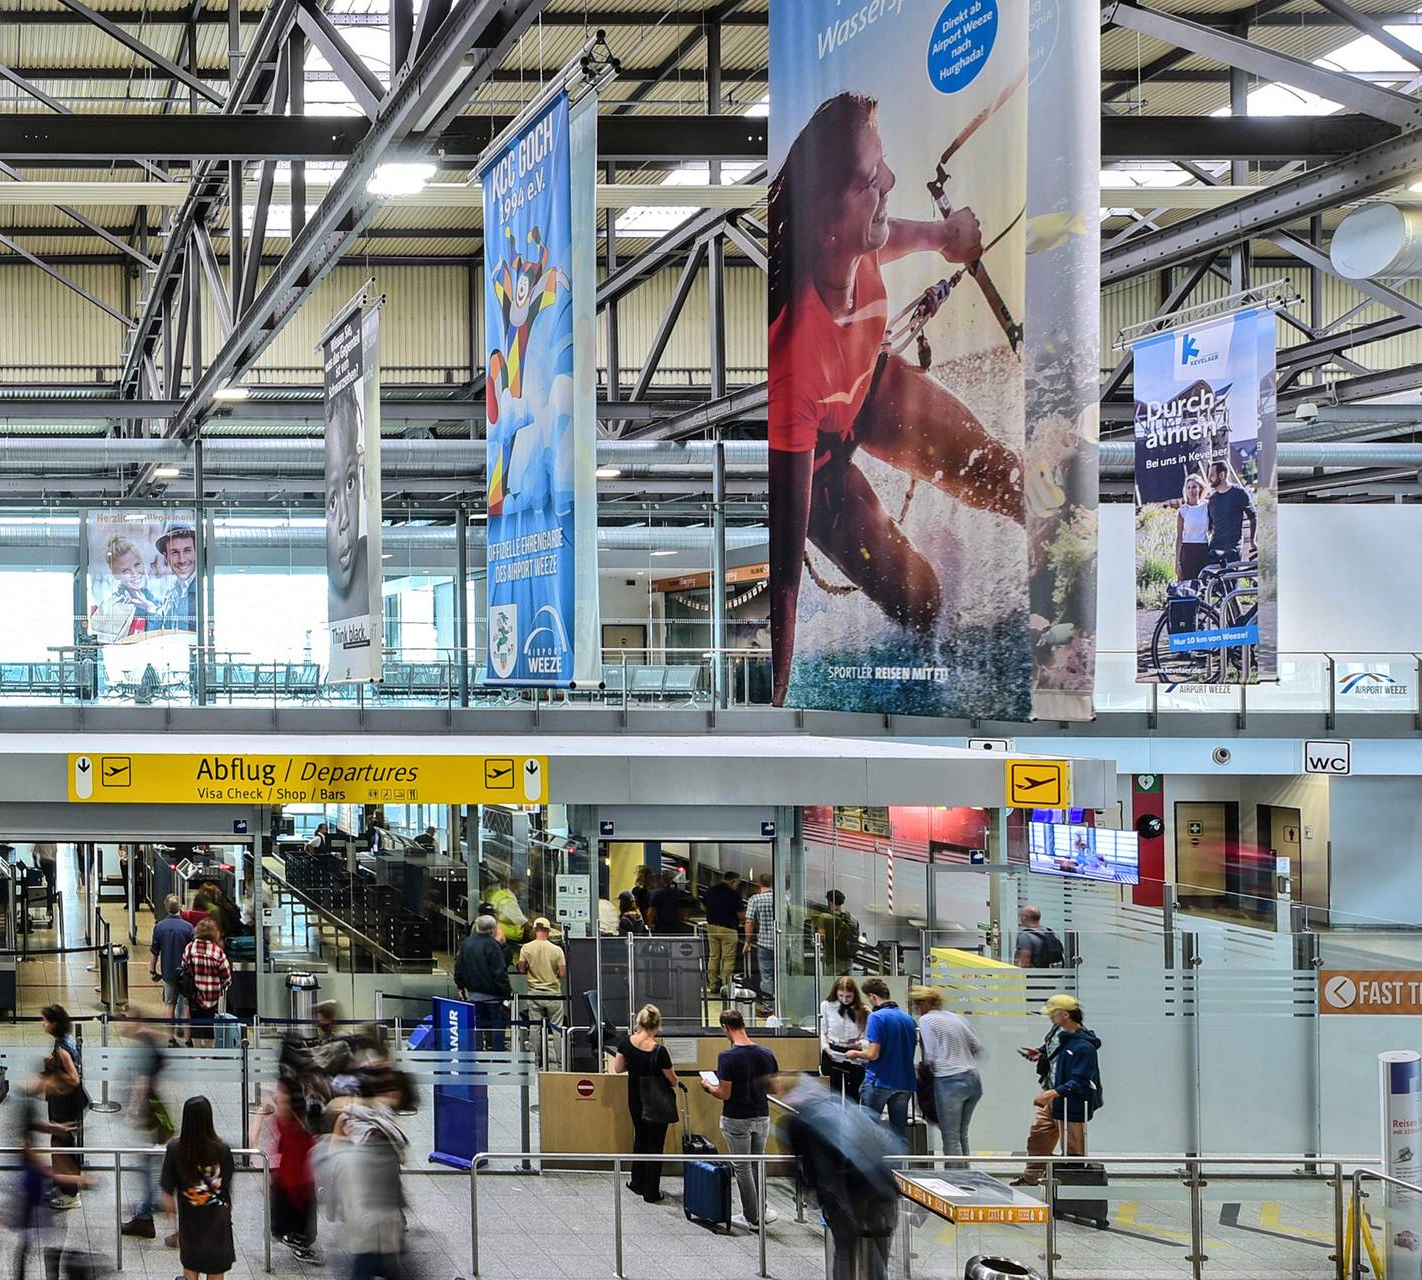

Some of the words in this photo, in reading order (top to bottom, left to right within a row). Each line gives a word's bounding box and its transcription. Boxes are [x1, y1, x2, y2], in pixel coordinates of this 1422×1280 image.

[942, 9, 968, 33] Direkt
[969, 1, 982, 15] ab
[932, 29, 962, 56] Airport
[962, 10, 994, 35] Weeze
[951, 38, 972, 58] nach
[939, 45, 984, 80] Hurghada!
[492, 149, 515, 203] KCC
[519, 111, 553, 179] GOCH
[499, 188, 525, 225] 1994
[528, 167, 546, 201] e.V.
[1190, 354, 1219, 366] KEVELAER
[1145, 420, 1217, 449] atmen
[1146, 459, 1159, 469] Bei
[1161, 457, 1177, 467] uns
[1178, 454, 1187, 463] in
[97, 513, 132, 524] Herzlic
[489, 537, 520, 562] OFFIZIELLE
[521, 527, 564, 554] EHRENGARDE
[495, 563, 507, 583] DES
[508, 559, 534, 581] AIRPORT
[535, 554, 558, 577] WEEZE
[331, 626, 348, 645] Think
[1173, 638, 1186, 646] Nur
[1187, 637, 1196, 645] 10
[1208, 635, 1221, 643] von
[1222, 631, 1249, 641] Weeze!
[528, 647, 562, 656] AIRPORT
[529, 657, 562, 673] WEEZE
[828, 665, 873, 679] SPORTLER
[875, 666, 910, 680] REISEN
[912, 667, 933, 681] MIT
[1179, 685, 1208, 694] AIRPORT
[1209, 685, 1231, 694] WEEZE
[1355, 685, 1383, 695] AIRPORT
[1385, 685, 1407, 695] WEEZE
[196, 757, 276, 786] Abflug
[284, 758, 293, 783] /
[301, 762, 419, 786] Departures
[1309, 757, 1346, 771] WC
[197, 787, 223, 800] Visa
[228, 787, 263, 800] Check
[267, 787, 273, 801] /
[276, 788, 307, 803] Shop
[310, 787, 316, 801] /
[320, 788, 346, 800] Bars
[1359, 981, 1404, 1005] FAST
